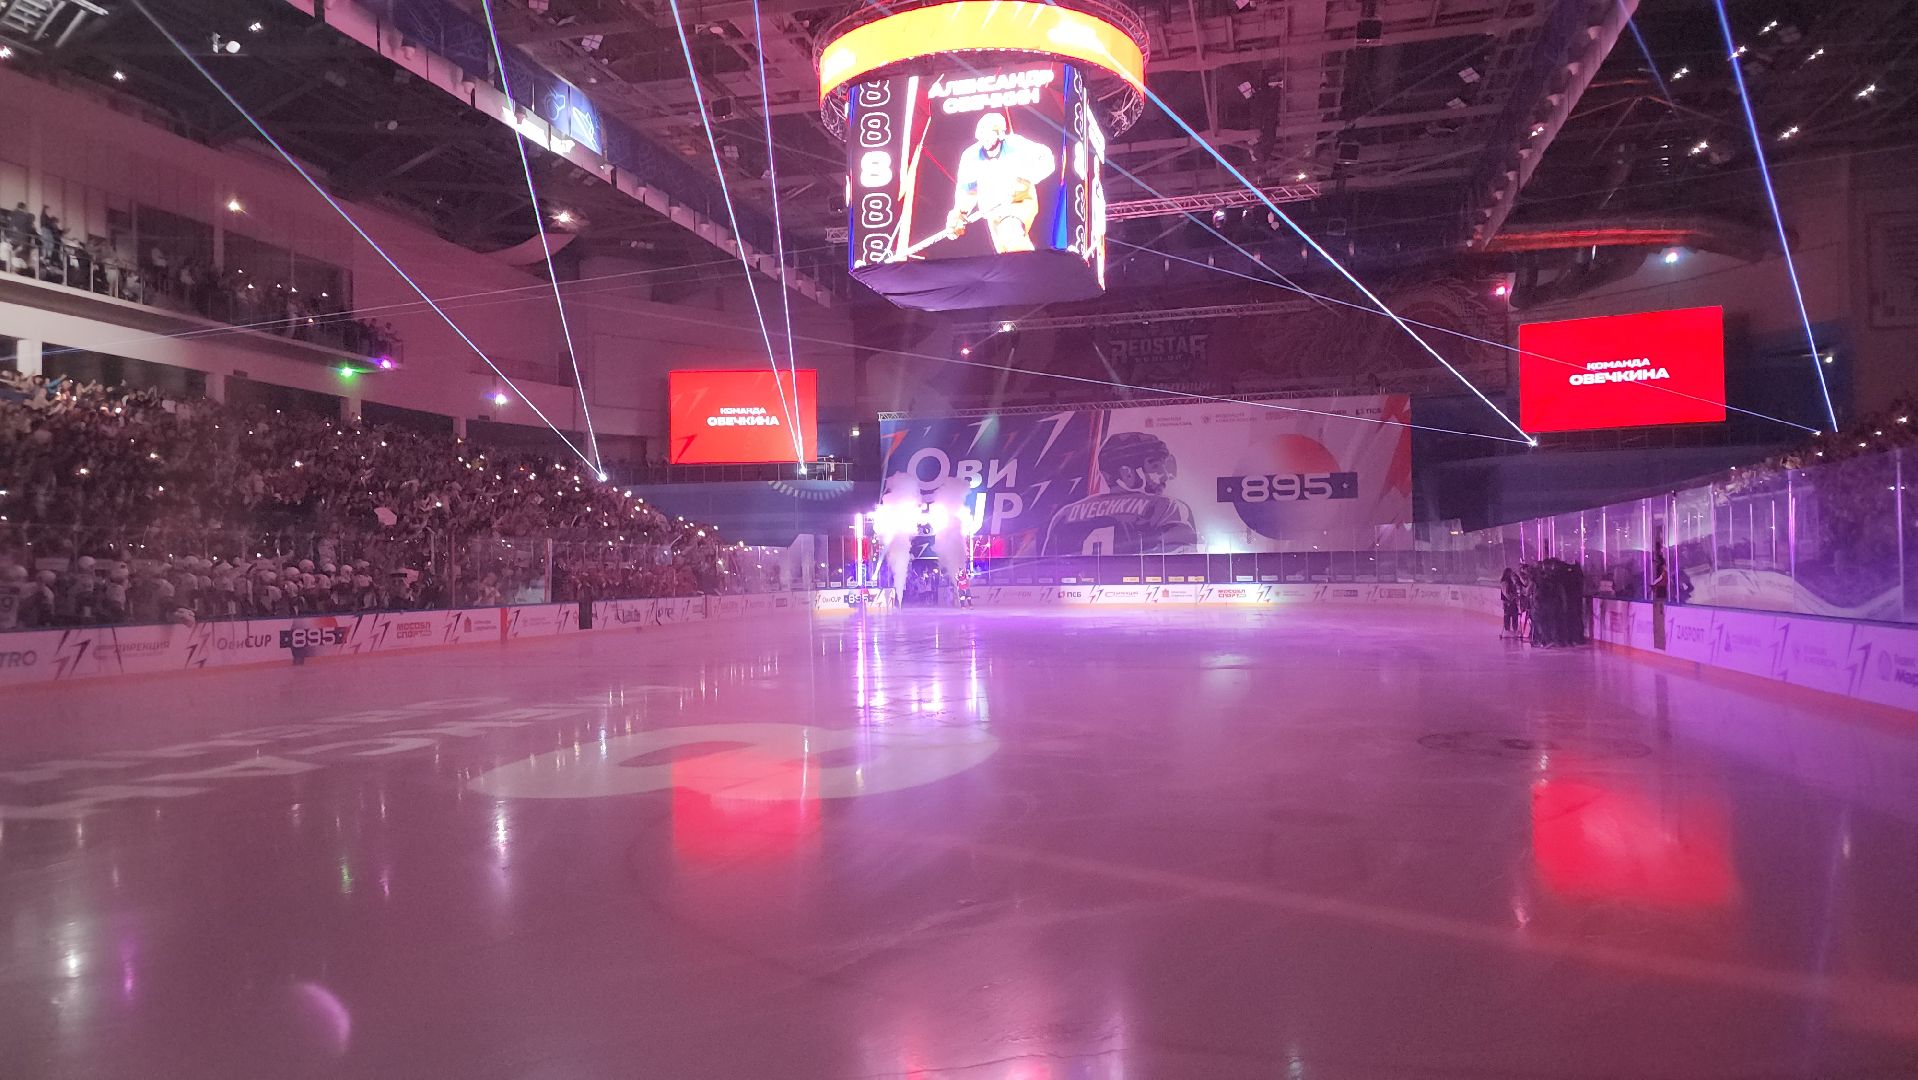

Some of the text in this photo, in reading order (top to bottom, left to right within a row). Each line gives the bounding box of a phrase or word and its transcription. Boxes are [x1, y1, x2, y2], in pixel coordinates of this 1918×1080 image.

[860, 112, 891, 147] 8
[860, 151, 892, 187] 8
[862, 193, 892, 228] 8
[1586, 357, 1651, 370] КОМАНДА
[1568, 367, 1670, 386] ОВЕЧКИНА
[706, 415, 780, 426] ОВЕЧКИНА
[719, 407, 767, 415] КОМАНДА
[907, 447, 1018, 491] Ови
[1241, 472, 1333, 503] 895
[1067, 499, 1149, 521] OVECHKIN
[292, 627, 336, 648] 895
